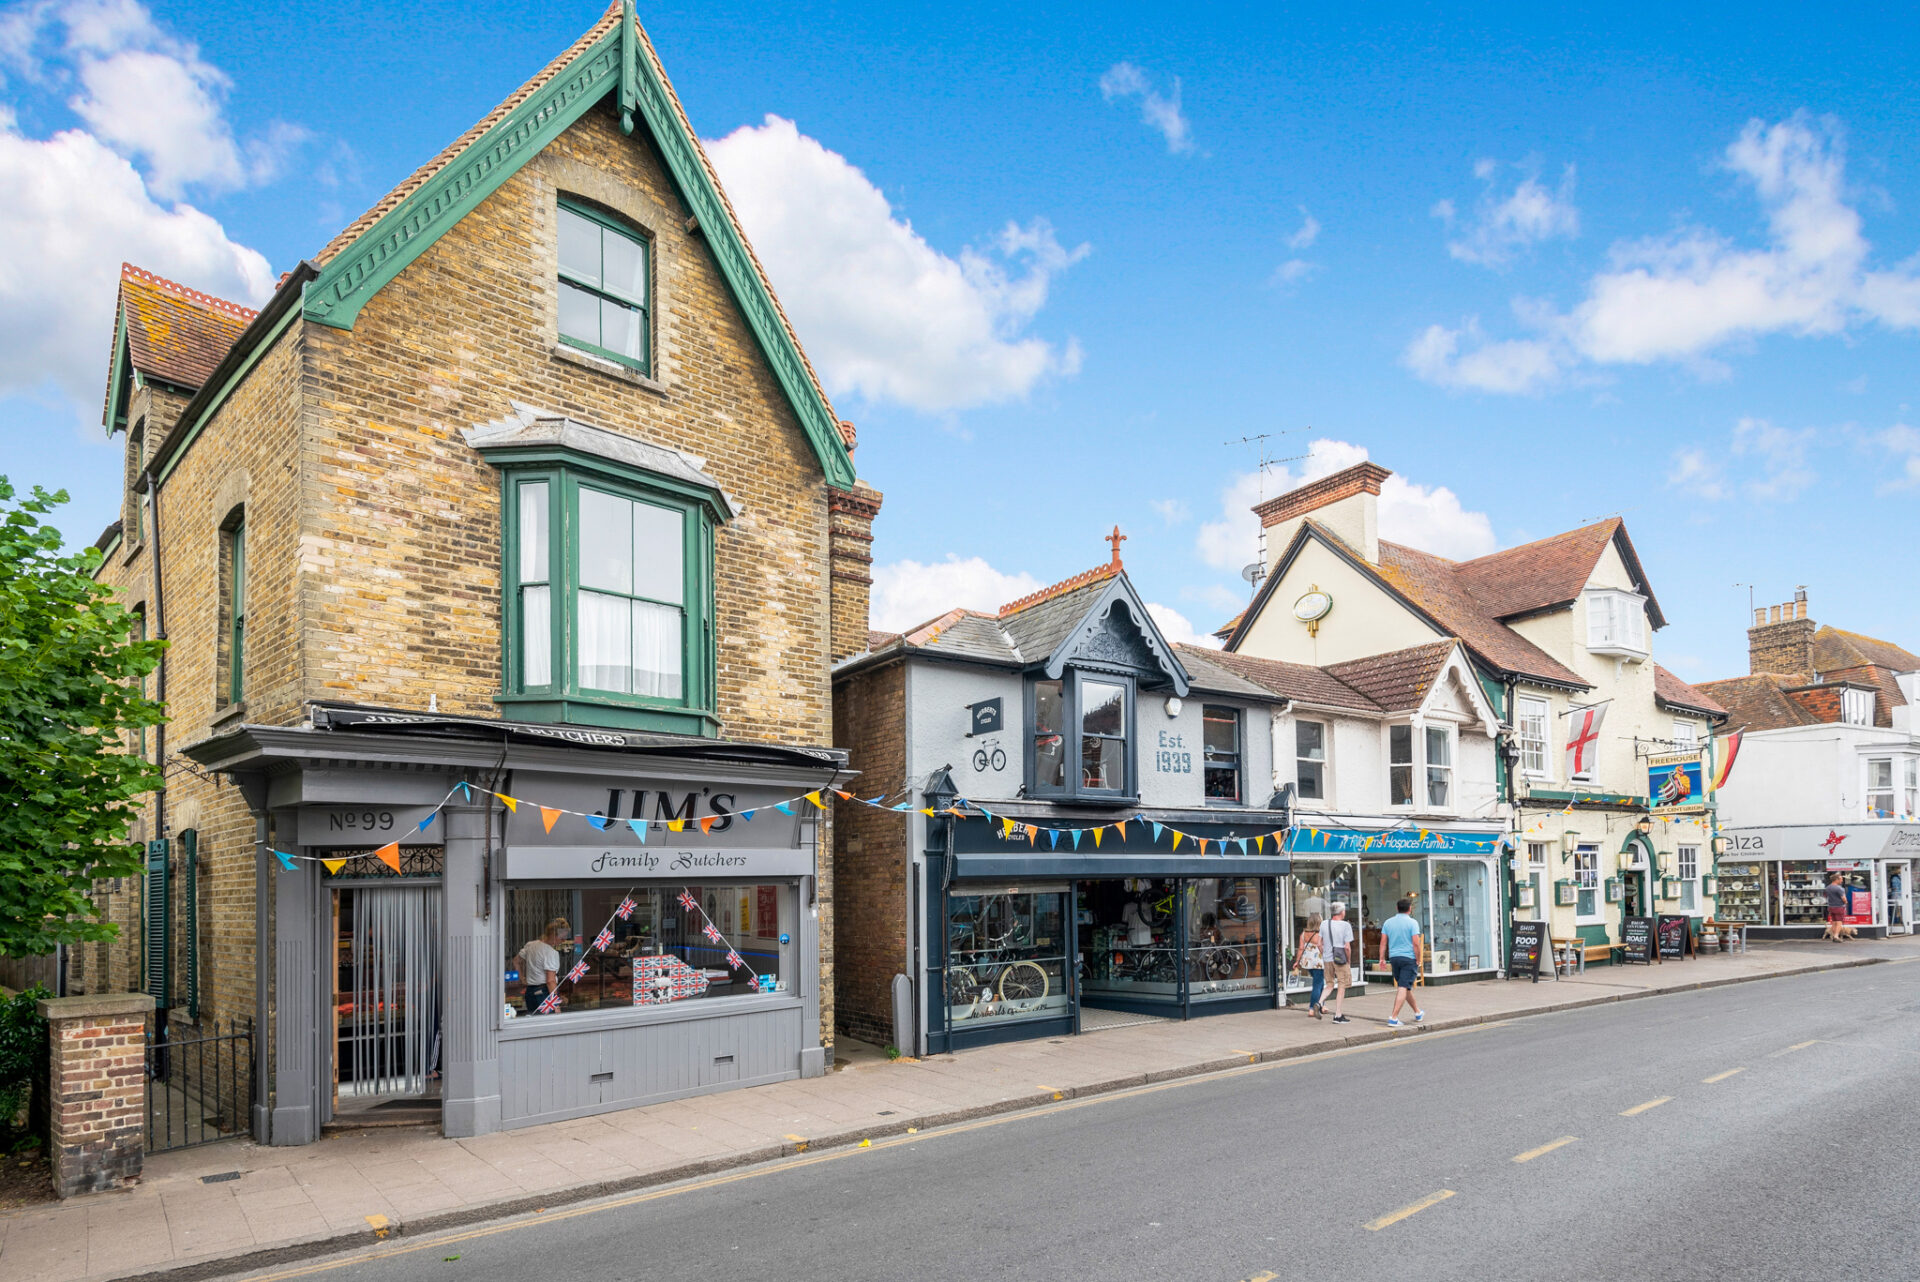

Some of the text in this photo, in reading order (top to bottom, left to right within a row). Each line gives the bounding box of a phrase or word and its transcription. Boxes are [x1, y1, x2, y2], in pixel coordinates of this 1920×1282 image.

[1158, 730, 1187, 748] Est.
[1156, 751, 1192, 773] 1939
[1650, 754, 1699, 765] FREEHOUSE
[593, 787, 736, 833] JIM'S
[362, 811, 394, 831] 99
[1384, 834, 1420, 852] Hospices
[670, 852, 748, 872] Butchers
[1515, 936, 1538, 945] FOOD
[1626, 935, 1648, 943] ROAST
